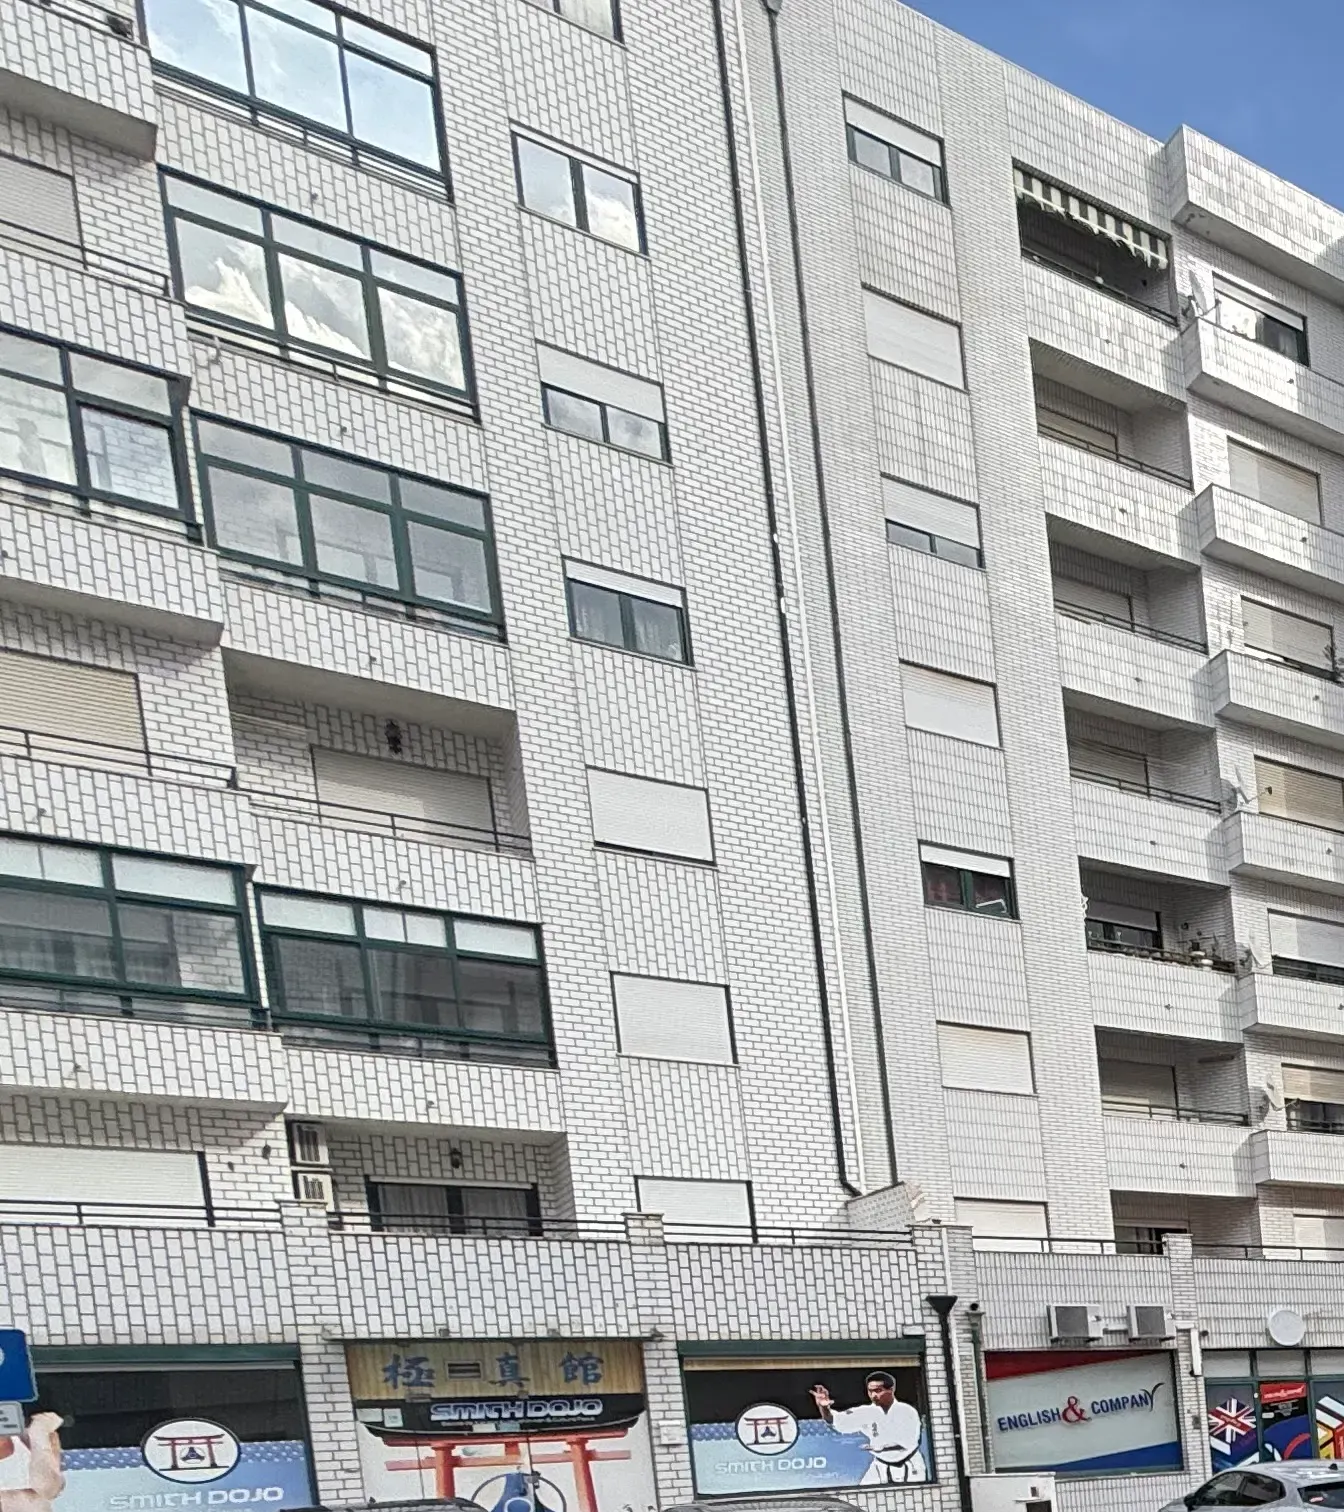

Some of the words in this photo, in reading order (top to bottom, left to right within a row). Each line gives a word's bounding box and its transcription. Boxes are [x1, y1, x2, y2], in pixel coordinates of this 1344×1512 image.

[430, 1402, 523, 1421] SMITH
[527, 1399, 603, 1417] DOJO
[997, 1407, 1061, 1432] ENGLISH
[1062, 1396, 1093, 1424] &
[1091, 1382, 1165, 1415] COMPANY
[715, 1460, 774, 1475] SMITH
[777, 1456, 827, 1471] DOJO
[110, 1491, 201, 1510] SMITH
[208, 1487, 285, 1505] DOJO
